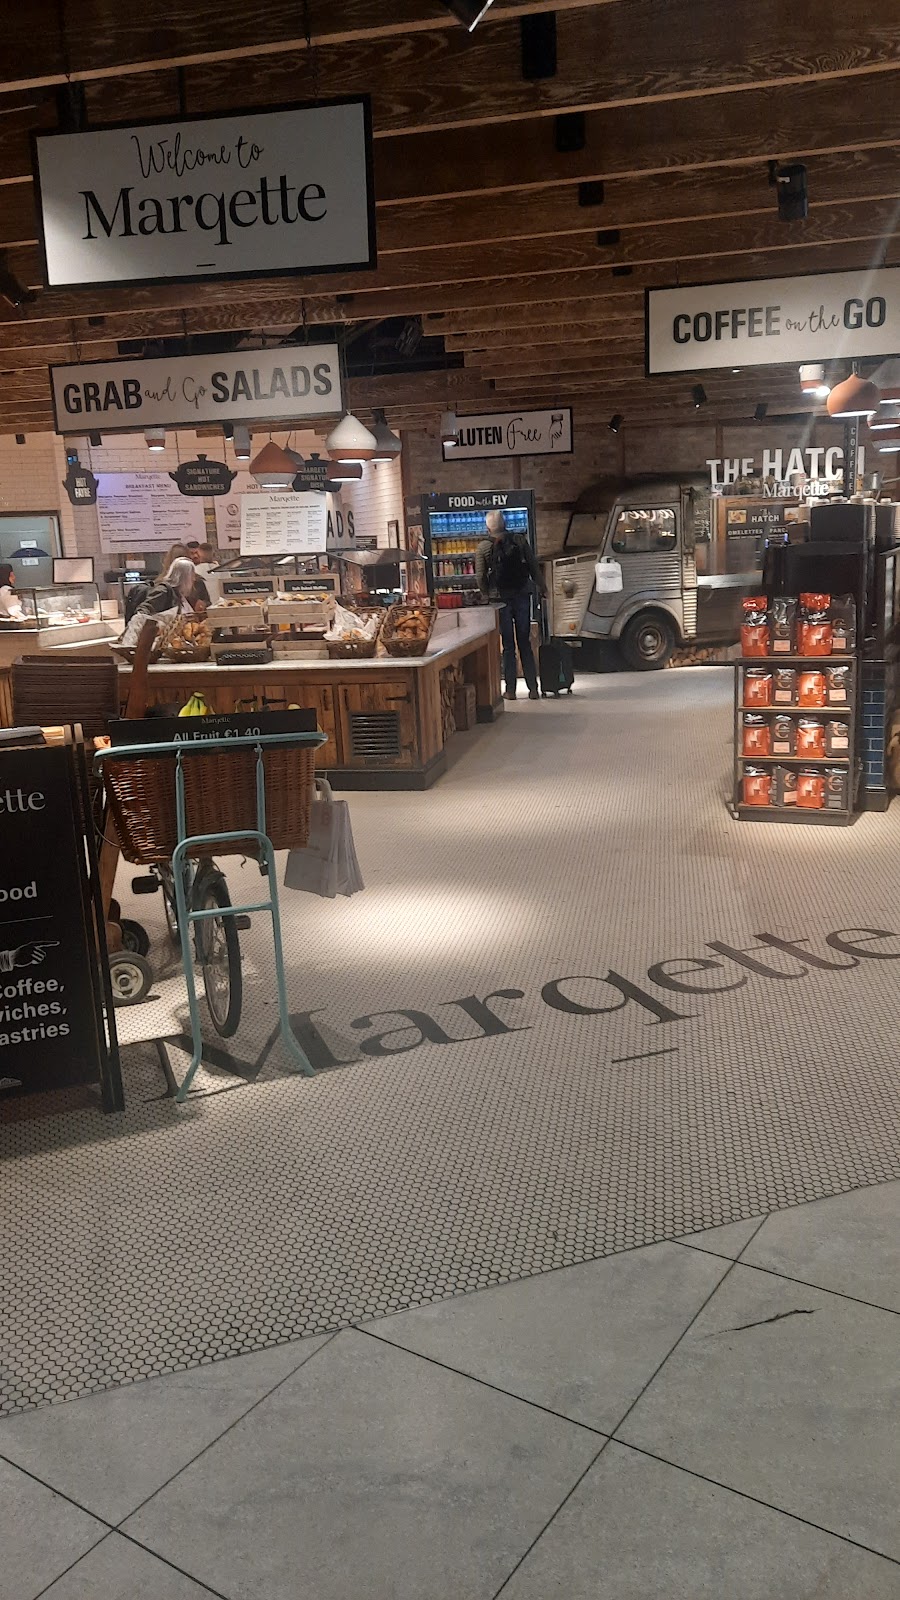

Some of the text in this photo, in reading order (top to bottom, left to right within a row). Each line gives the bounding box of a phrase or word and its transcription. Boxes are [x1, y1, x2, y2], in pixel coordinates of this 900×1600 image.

[131, 132, 264, 179] Welcome to
[78, 174, 327, 246] Marqette
[673, 296, 886, 344] COFFEE on the GO
[63, 363, 332, 414] GRAB and Go SALADS
[506, 417, 541, 450] Free
[848, 426, 856, 491] COFFEE
[186, 467, 220, 475] SIGNATURE
[198, 475, 210, 483] HOT
[705, 458, 754, 486] THE
[75, 477, 87, 487] HOT
[184, 483, 225, 491] SANDWICHES
[763, 482, 829, 501] Marqette
[269, 495, 300, 503] Marqette
[448, 496, 475, 507] FOOD
[492, 494, 508, 506] FLY
[751, 515, 780, 523] HATCH
[727, 528, 763, 536] OMELETTES
[173, 727, 261, 742] All Fruit €140
[0, 1001, 67, 1022] iches,
[118, 928, 900, 1103] Marqette
[0, 1023, 70, 1046] astries
